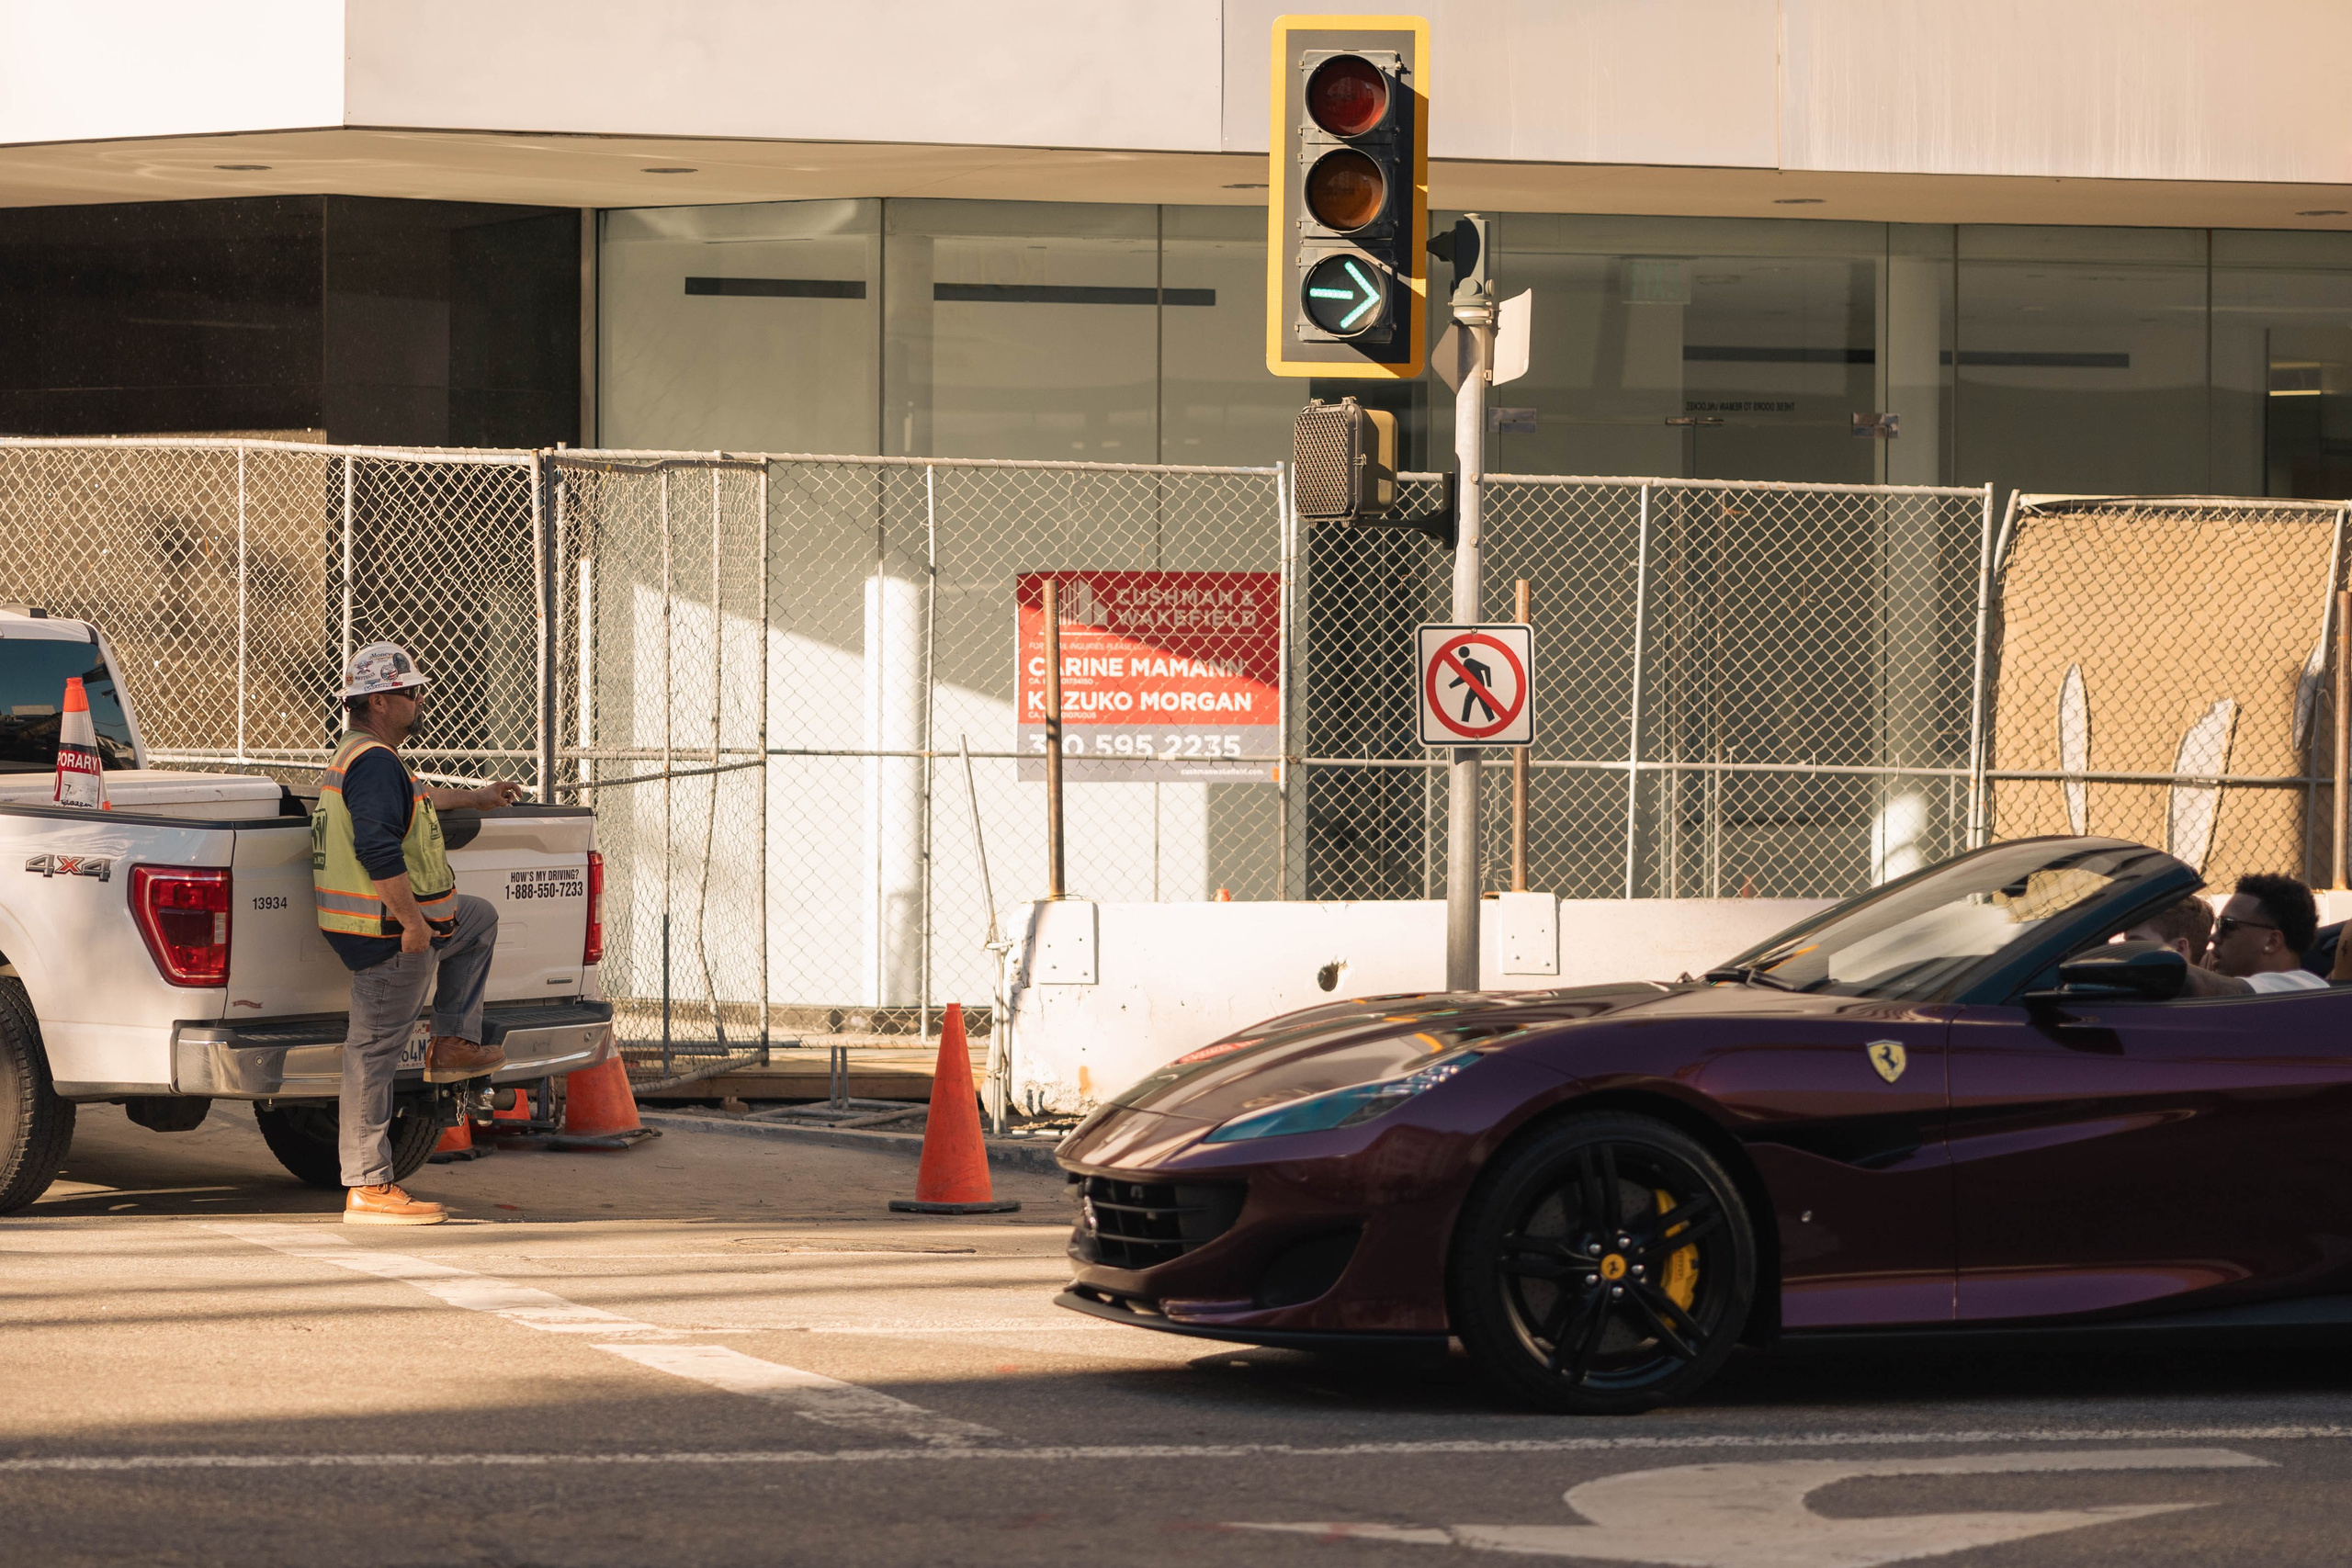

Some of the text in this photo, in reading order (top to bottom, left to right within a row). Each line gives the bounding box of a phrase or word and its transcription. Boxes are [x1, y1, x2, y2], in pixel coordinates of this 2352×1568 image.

[1115, 588, 1255, 607] CUSHMAN &
[1115, 609, 1257, 627] WAKEFIELD
[1028, 656, 1245, 678] CRINE MAMANN
[1027, 690, 1252, 711] KZUKO MORGAN
[1028, 733, 1241, 758] 30 595 2235
[510, 869, 580, 883] HOW'S MY DRIVING?
[505, 881, 583, 900] 1-888-550-7233
[252, 897, 288, 909] 13934
